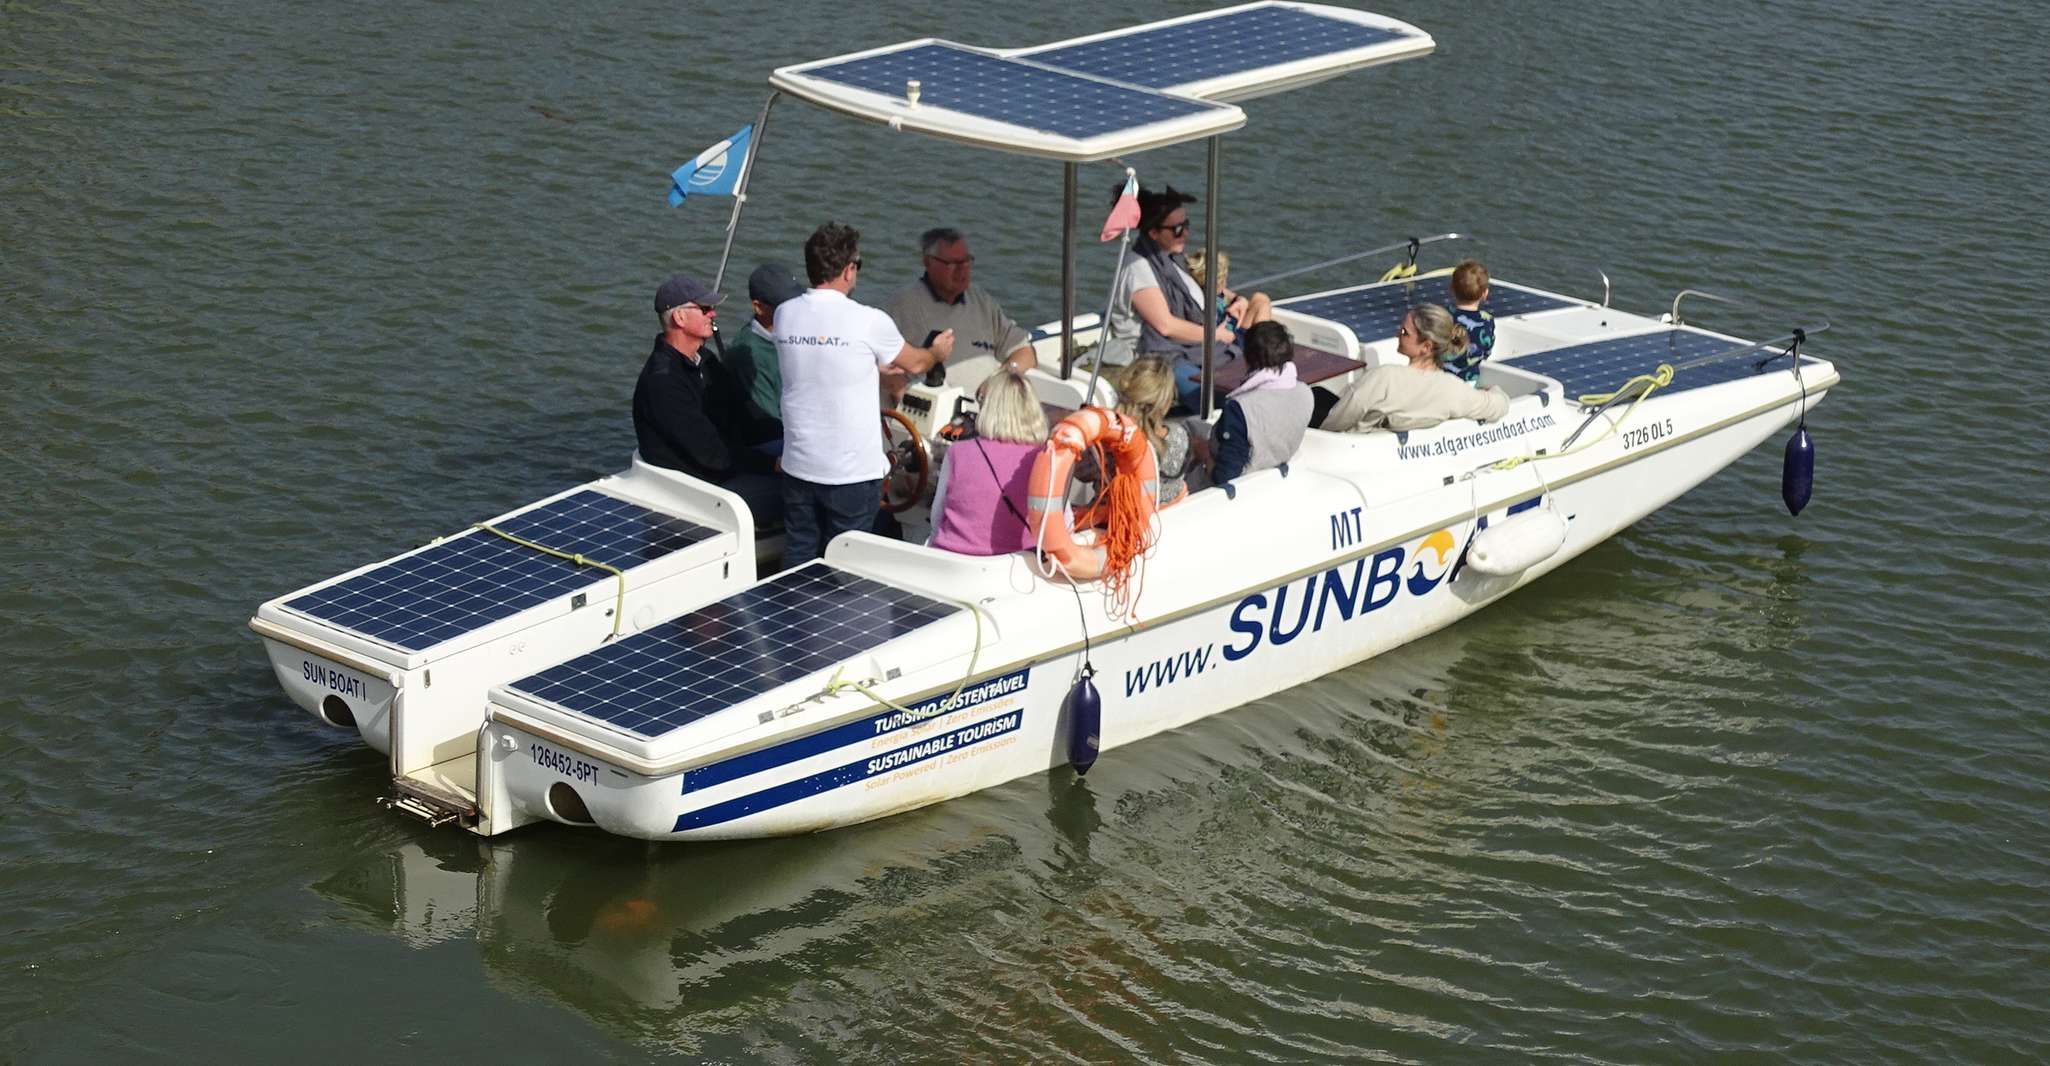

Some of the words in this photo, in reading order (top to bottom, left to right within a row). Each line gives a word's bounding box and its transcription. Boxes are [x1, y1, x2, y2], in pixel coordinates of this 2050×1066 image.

[1397, 413, 1556, 460] www.algarvesunboat.com
[1623, 430, 1649, 450] 3726
[1666, 419, 1673, 435] 5
[1330, 507, 1361, 550] MT
[1125, 496, 1543, 698] www.SUNBO
[303, 660, 326, 686] SUN
[329, 670, 359, 698] BOAT
[362, 682, 366, 701] I
[875, 704, 936, 733] TURISMO
[940, 675, 1025, 711] SUSTENTÁVEL
[867, 734, 955, 774] SUSTAINABLE
[957, 715, 1017, 746] TOURISM
[871, 728, 908, 749] Energia
[946, 708, 970, 726] Zero
[531, 743, 599, 786] 126452-5PT
[865, 772, 892, 791] Solar
[893, 760, 937, 782] Powered
[946, 750, 970, 765] Zero
[971, 736, 1017, 758] Emissions
